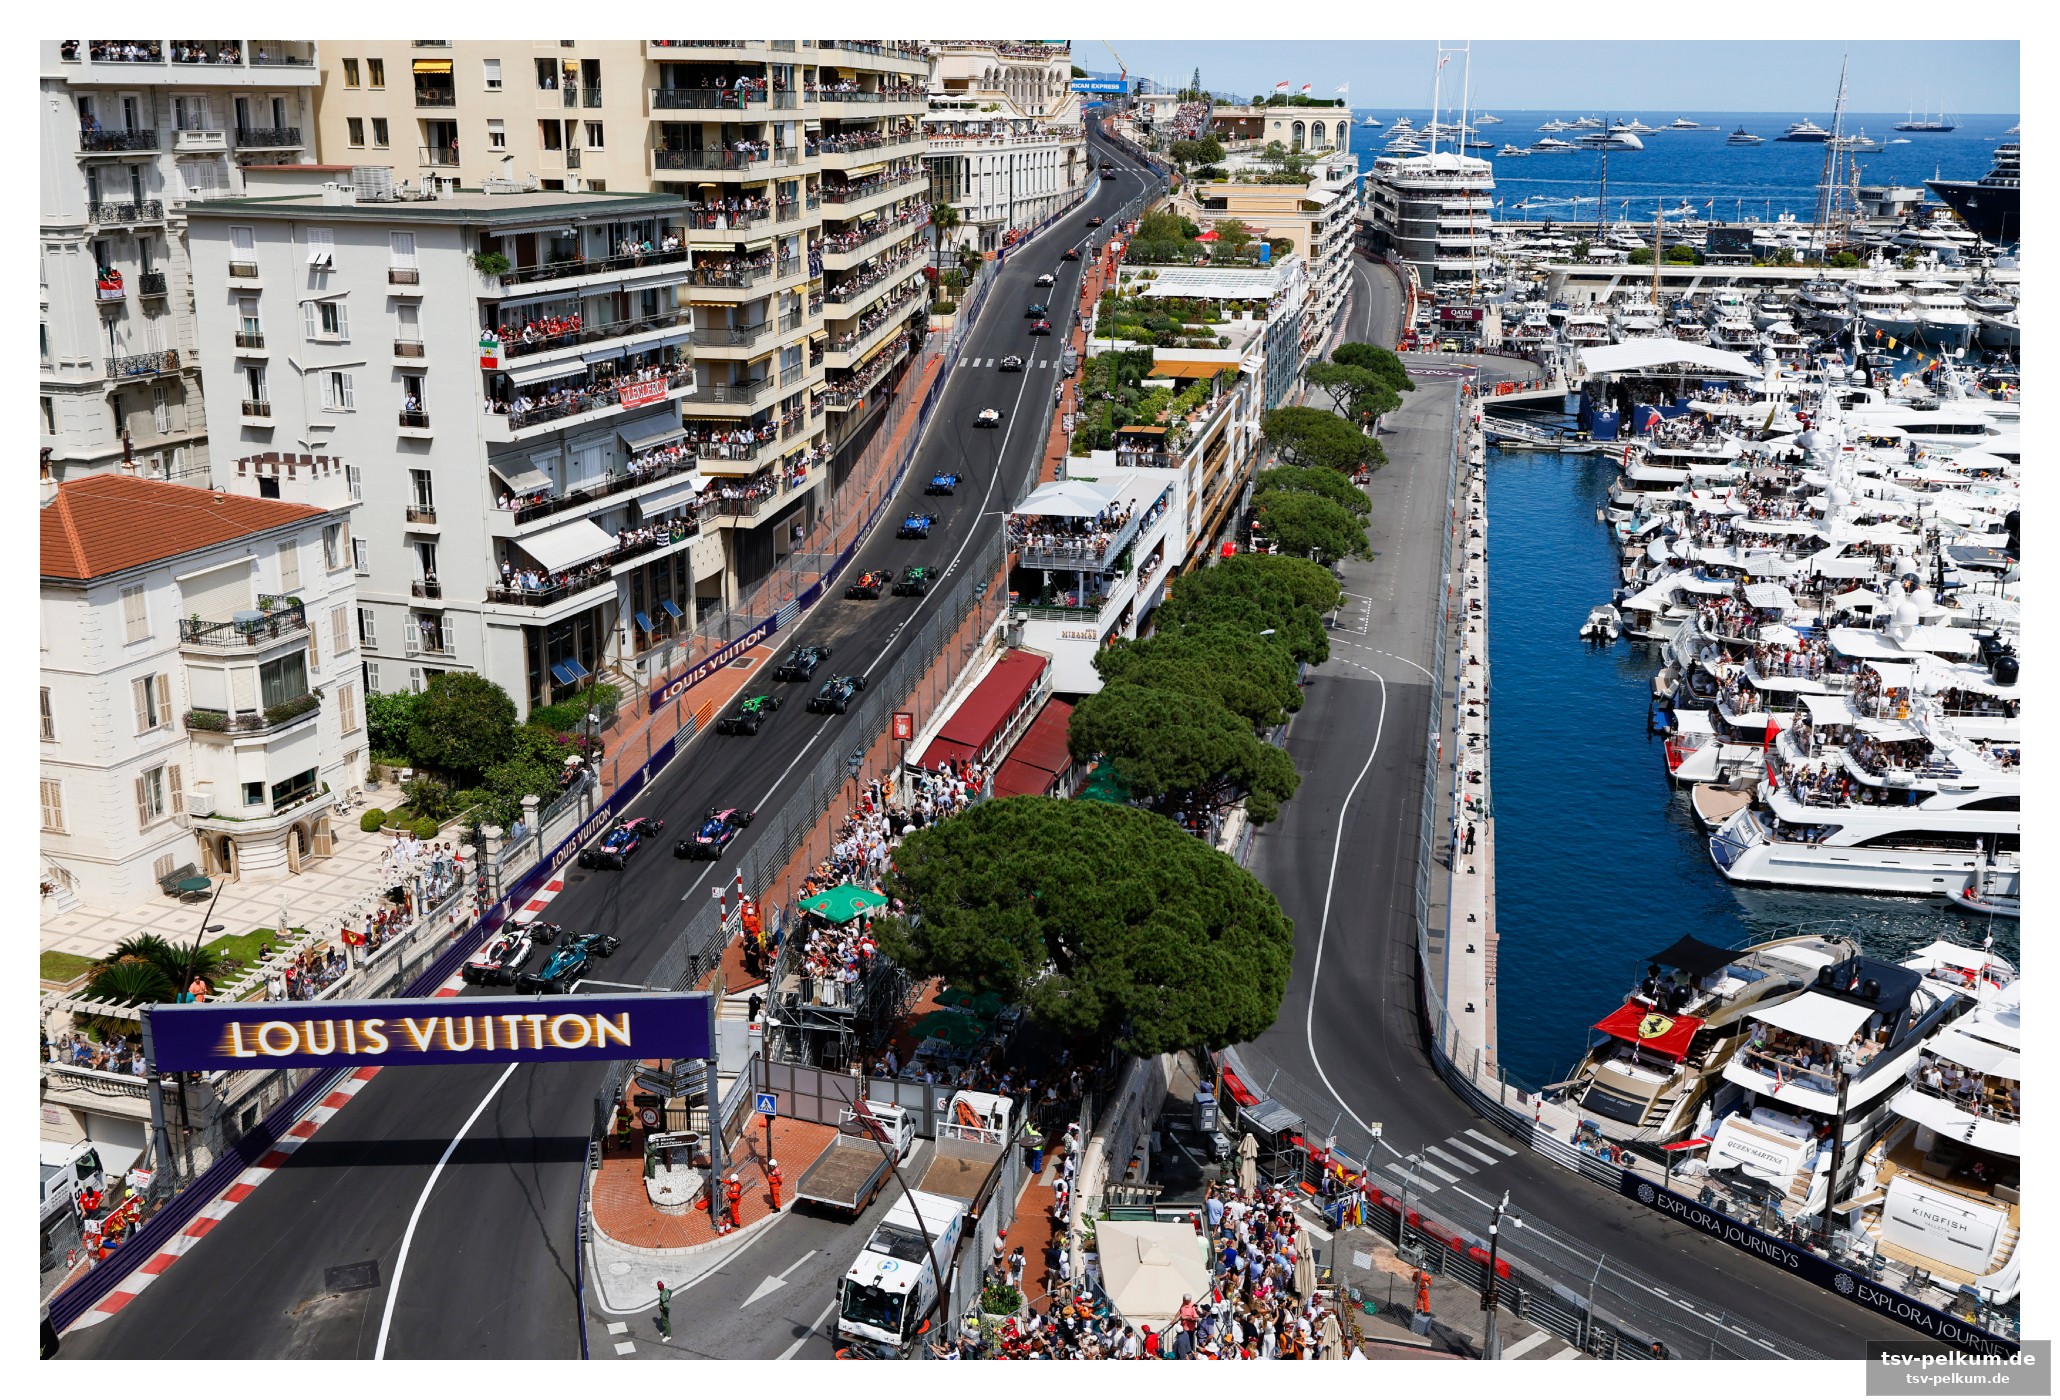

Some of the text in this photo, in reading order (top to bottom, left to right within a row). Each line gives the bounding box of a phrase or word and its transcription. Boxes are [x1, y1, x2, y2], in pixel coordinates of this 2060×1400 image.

[1483, 348, 1500, 356] QATAR
[1062, 631, 1097, 639] MIRAMAR
[663, 624, 767, 702] LOUIS VUITTON
[551, 803, 612, 871] LOUIS VUITTON
[231, 1012, 632, 1058] LOUIS VUITTON
[1727, 1140, 1783, 1165] QUEEN MARTINA
[1657, 1193, 1800, 1268] EXPLORA JOURNEYS
[1912, 1207, 1968, 1232] KINGFISH
[1857, 1284, 1934, 1330] EXPLORA
